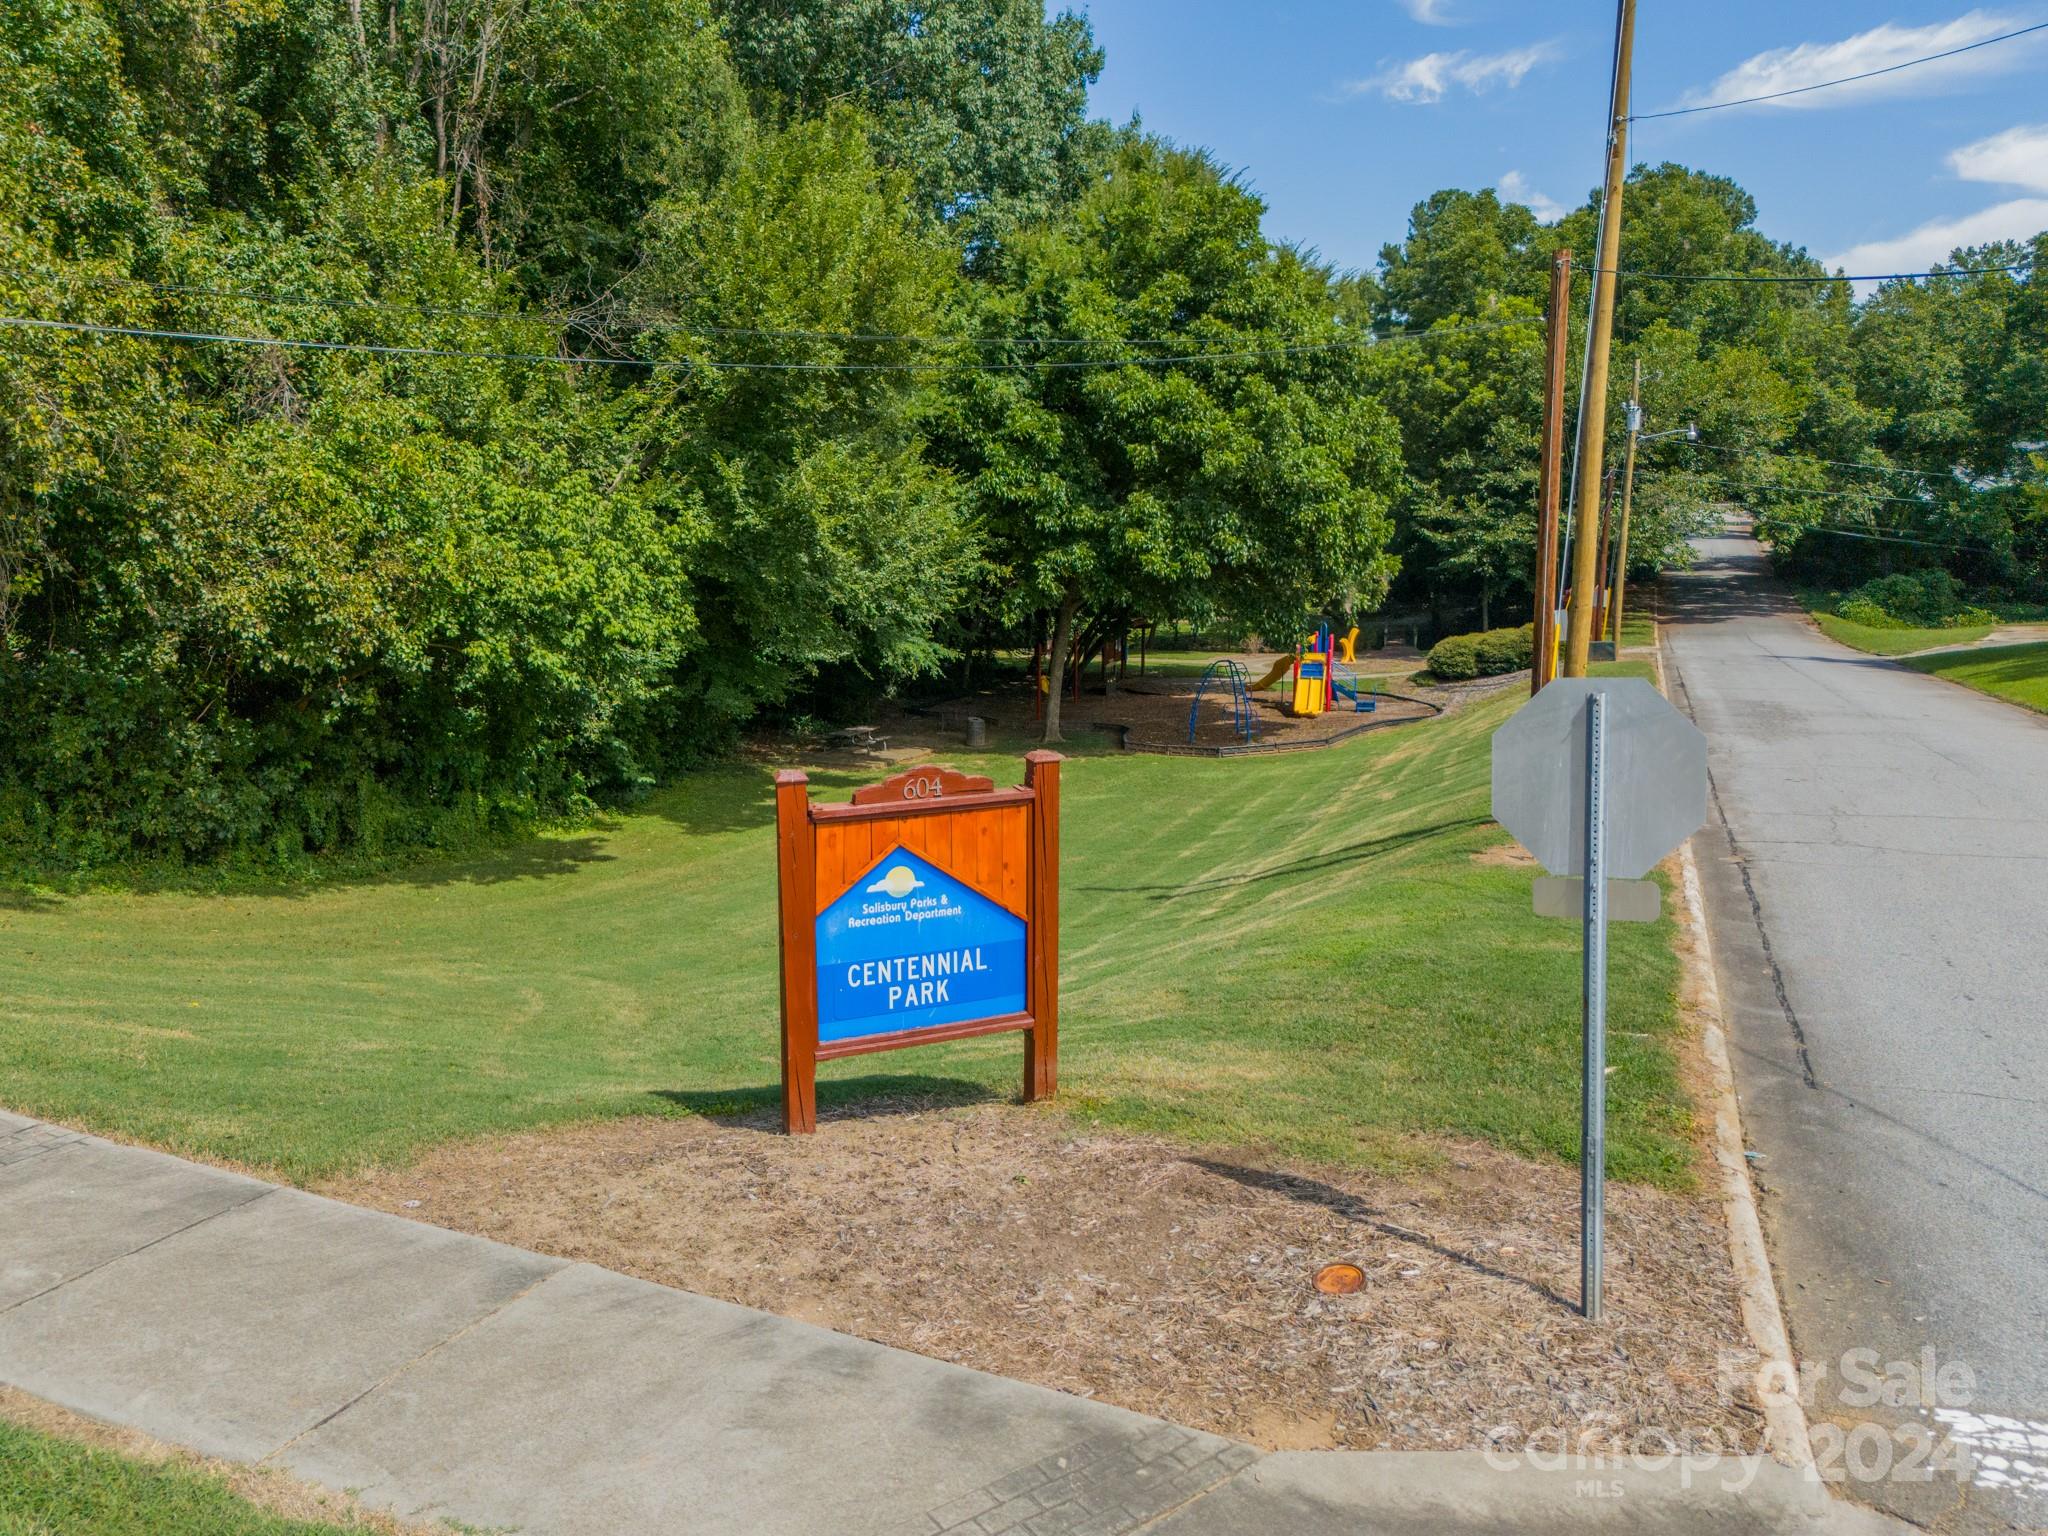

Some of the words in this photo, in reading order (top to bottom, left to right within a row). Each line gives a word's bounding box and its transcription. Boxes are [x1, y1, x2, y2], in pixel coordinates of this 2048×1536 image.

[903, 777, 943, 800] 604
[862, 901, 907, 914] Salisbury
[910, 897, 937, 908] Parks
[940, 894, 948, 906] &
[848, 913, 901, 928] Recreation
[904, 905, 962, 922] Department
[847, 948, 987, 988] CENTENNIAL
[888, 979, 949, 1009] PARK
